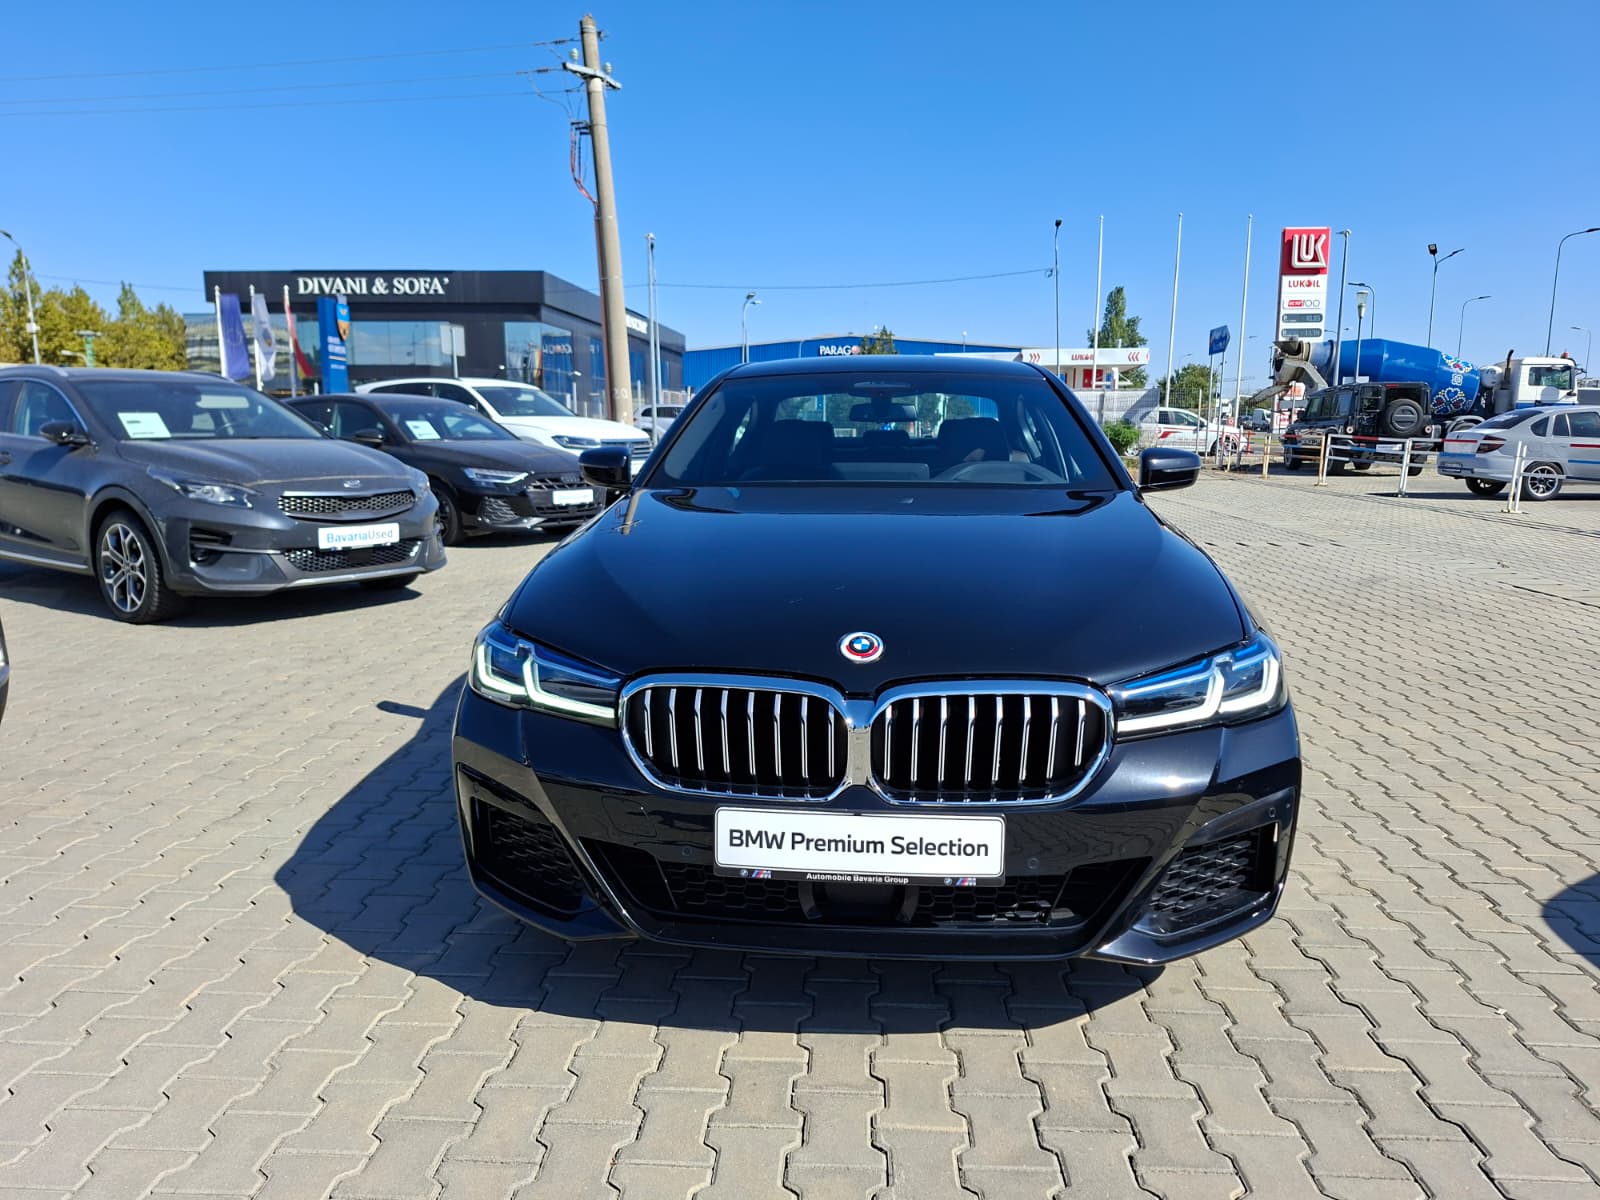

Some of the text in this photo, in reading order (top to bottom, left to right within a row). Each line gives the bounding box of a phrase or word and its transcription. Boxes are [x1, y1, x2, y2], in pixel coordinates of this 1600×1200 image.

[297, 277, 368, 295] DIVANI
[371, 277, 389, 295] &
[1288, 279, 1321, 288] LUKOIL
[326, 529, 393, 543] BavariaUsed
[729, 828, 989, 856] BMW Premium Selection
[806, 872, 909, 885] Automobile Bavaria Group
